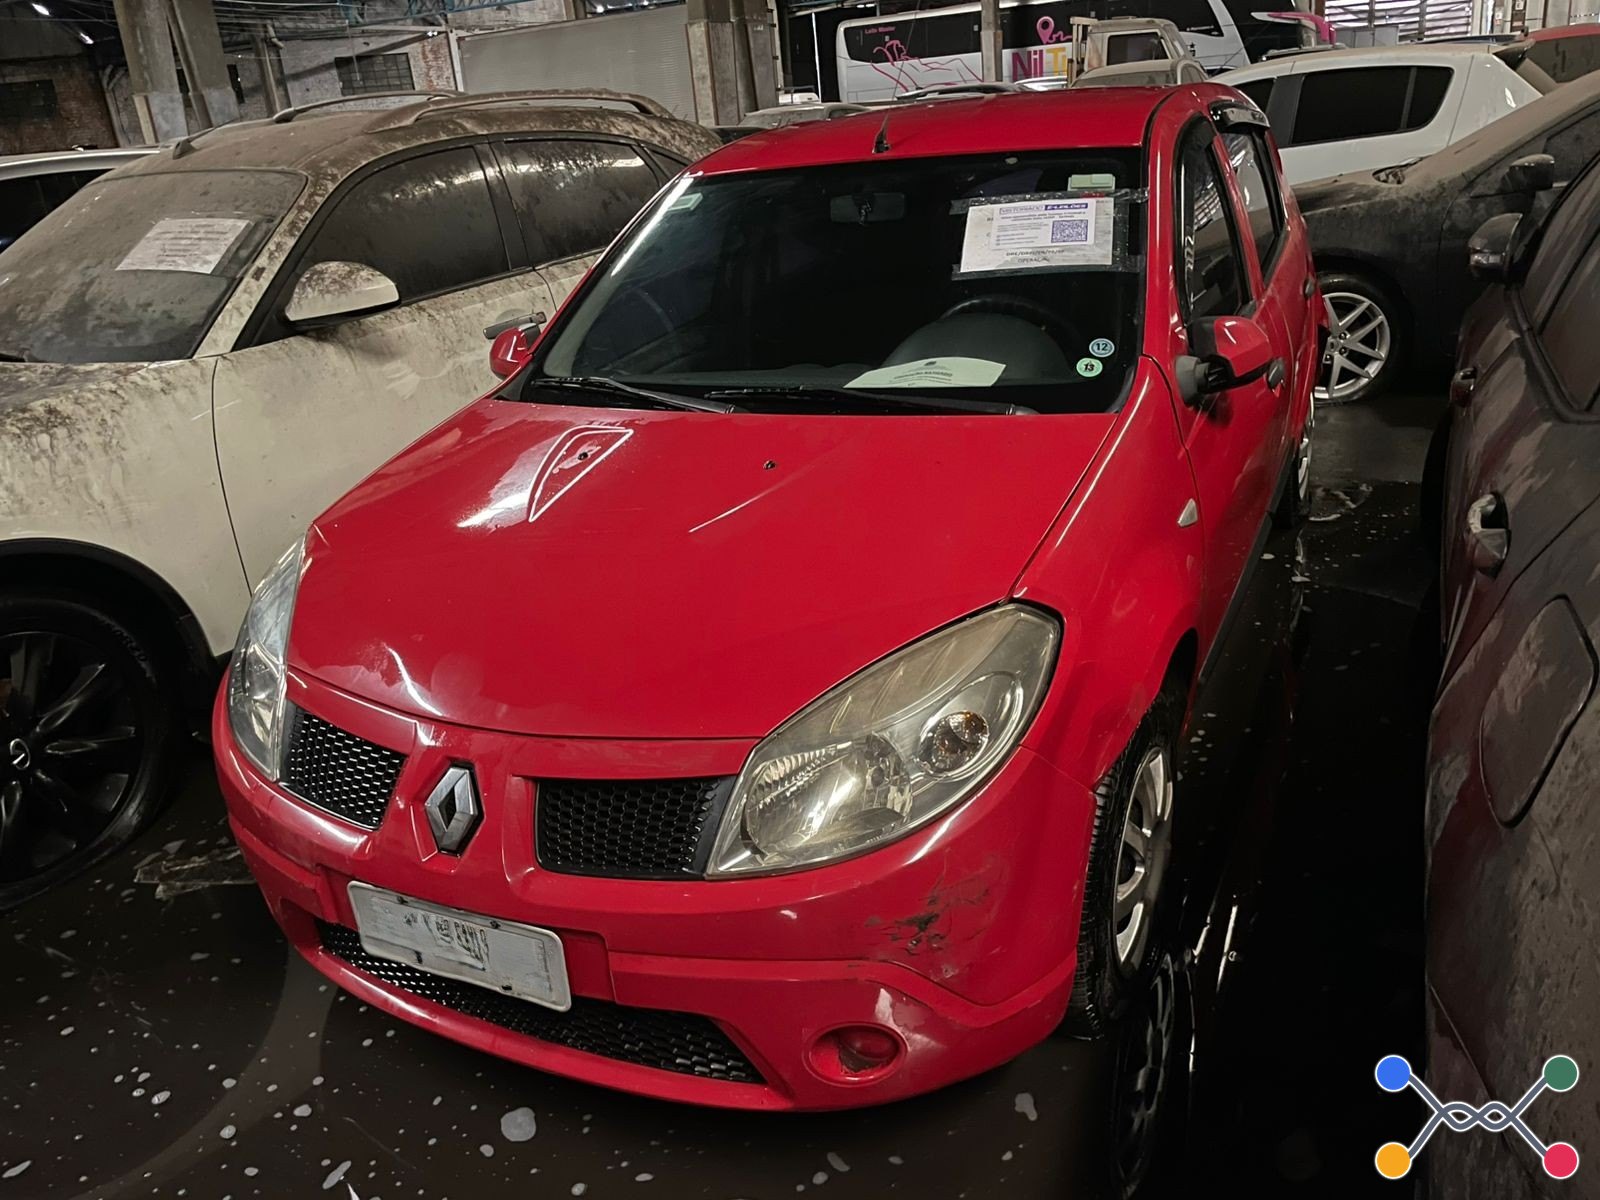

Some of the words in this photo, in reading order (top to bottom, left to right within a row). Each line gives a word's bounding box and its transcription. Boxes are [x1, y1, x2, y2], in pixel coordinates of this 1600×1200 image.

[1012, 49, 1044, 82] Nil
[1095, 342, 1108, 352] 12
[1084, 362, 1095, 372] 13
